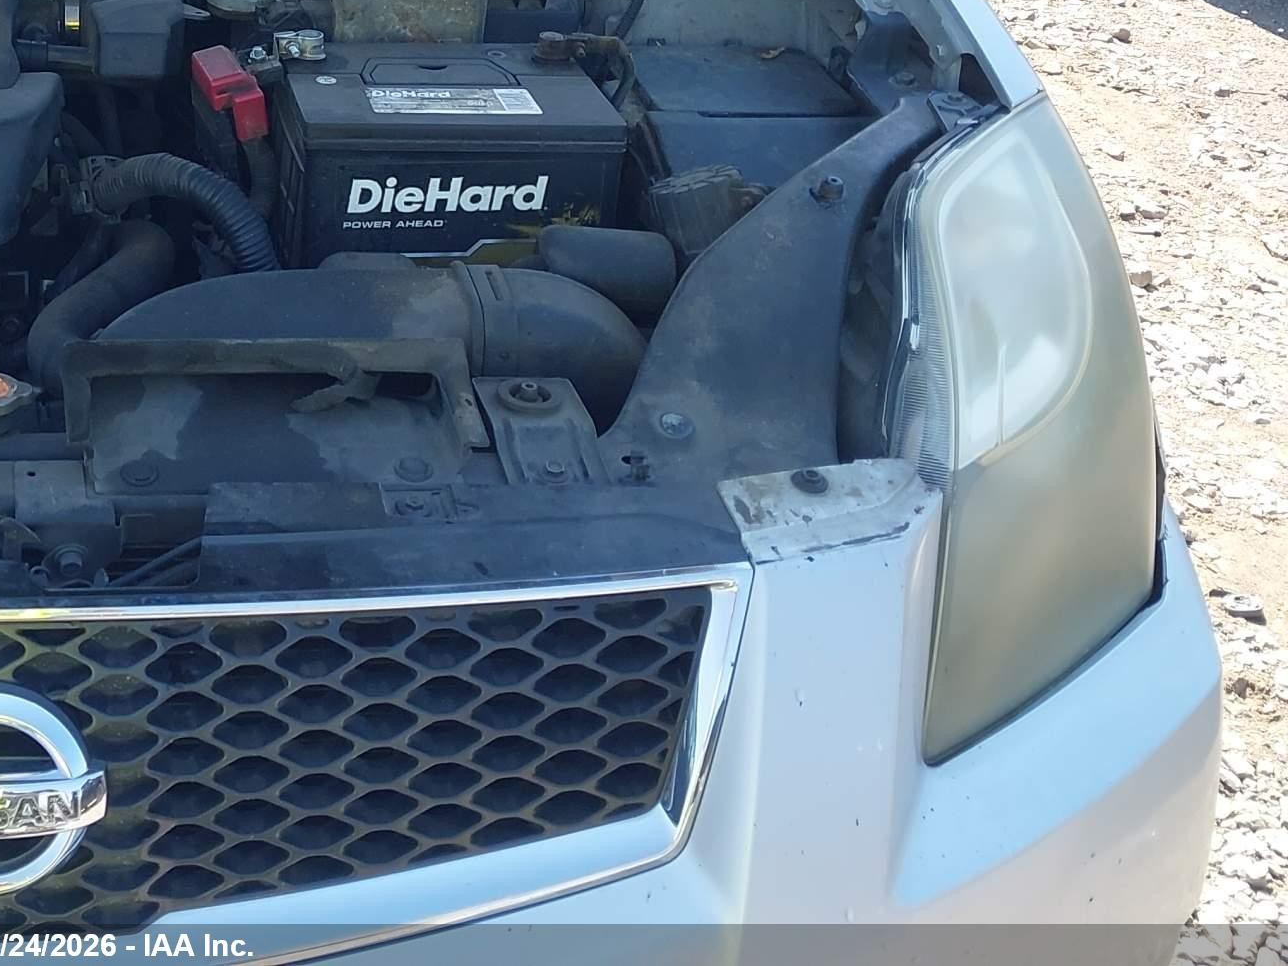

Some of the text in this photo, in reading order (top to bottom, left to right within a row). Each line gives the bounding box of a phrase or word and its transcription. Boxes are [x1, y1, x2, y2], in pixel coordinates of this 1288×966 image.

[347, 175, 549, 214] DieHard
[343, 219, 444, 229] POWER AHEAD
